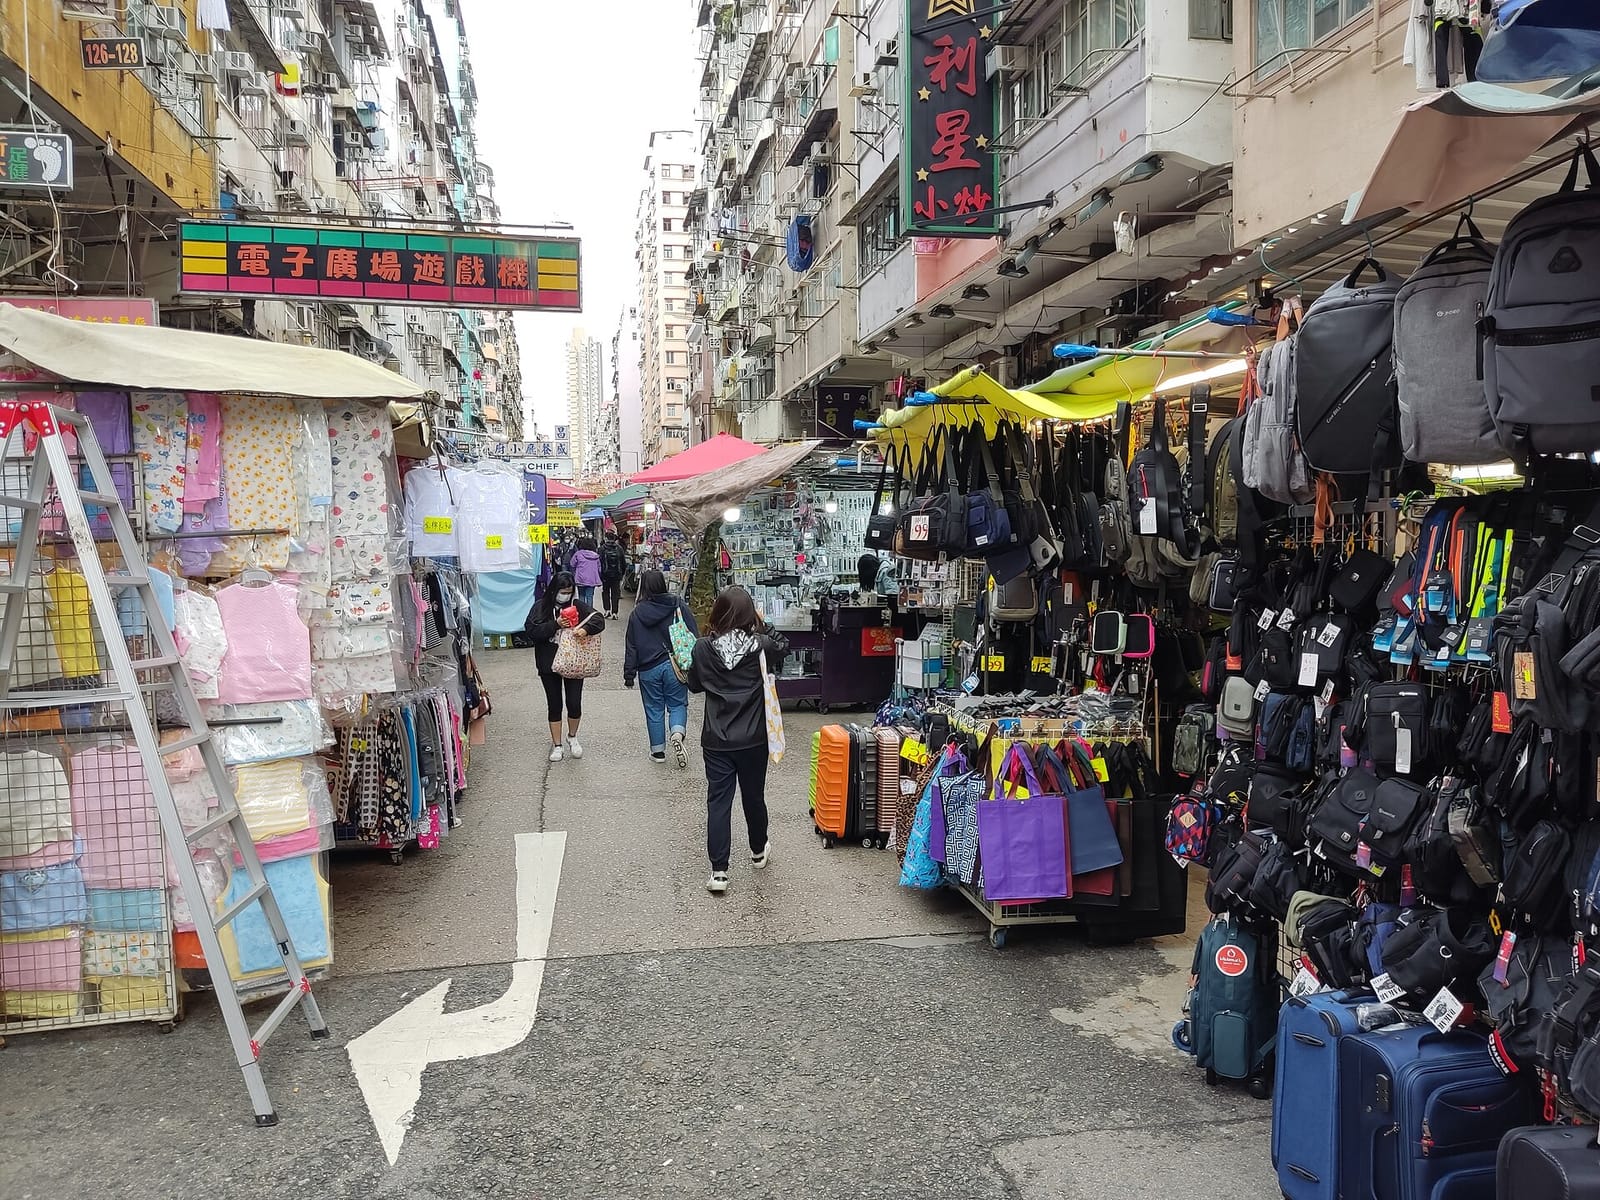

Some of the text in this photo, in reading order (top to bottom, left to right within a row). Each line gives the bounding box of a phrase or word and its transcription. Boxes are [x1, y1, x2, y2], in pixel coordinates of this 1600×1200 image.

[85, 42, 139, 65] 126-128
[923, 34, 981, 173] 利星
[914, 183, 992, 225] 小炒
[237, 244, 529, 288] 電子廣場遊戲機
[527, 462, 560, 471] CHIEF
